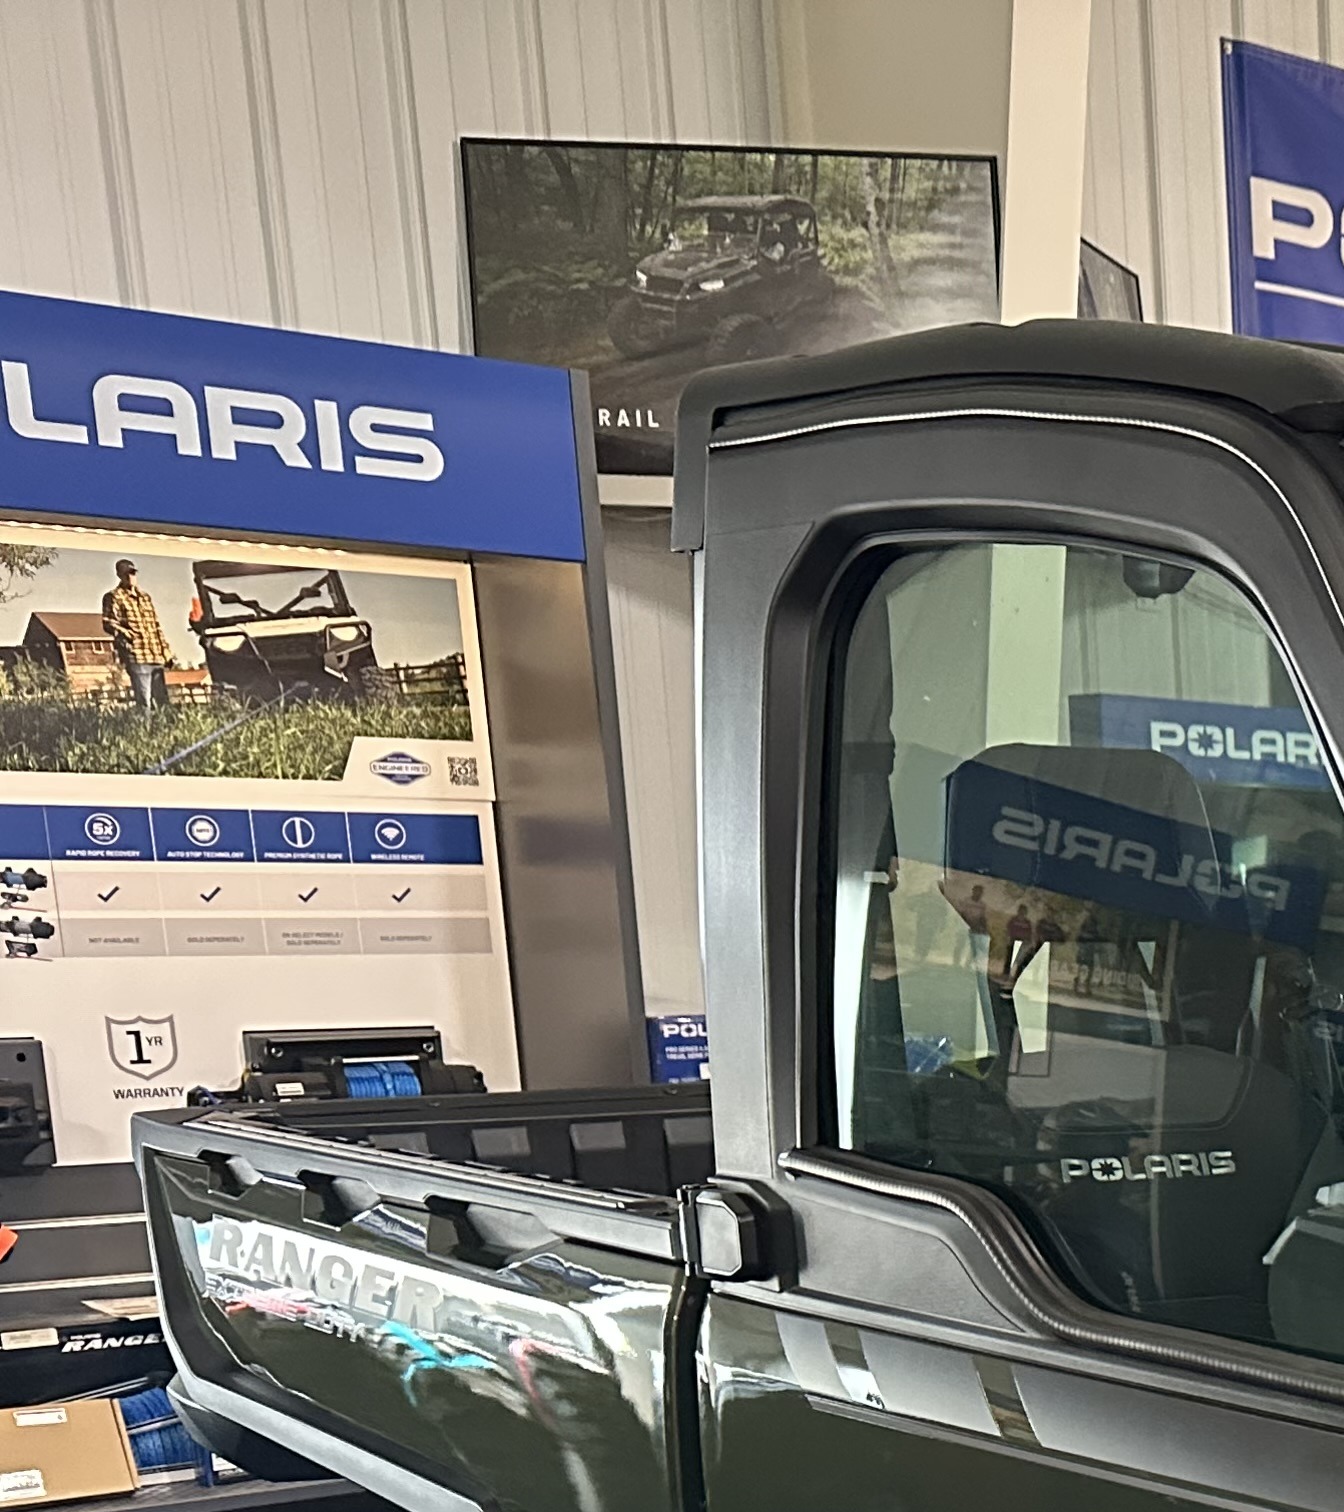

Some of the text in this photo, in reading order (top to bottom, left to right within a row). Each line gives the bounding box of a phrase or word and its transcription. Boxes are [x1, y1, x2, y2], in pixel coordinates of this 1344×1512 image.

[1, 360, 445, 482] LARIS
[598, 408, 660, 428] RAIL
[126, 1031, 163, 1064] 1 YR
[113, 1087, 185, 1100] WARRANTY
[1061, 1151, 1236, 1183] POLARIS
[209, 1222, 444, 1332] RANGER
[61, 1333, 167, 1353] RANGE
